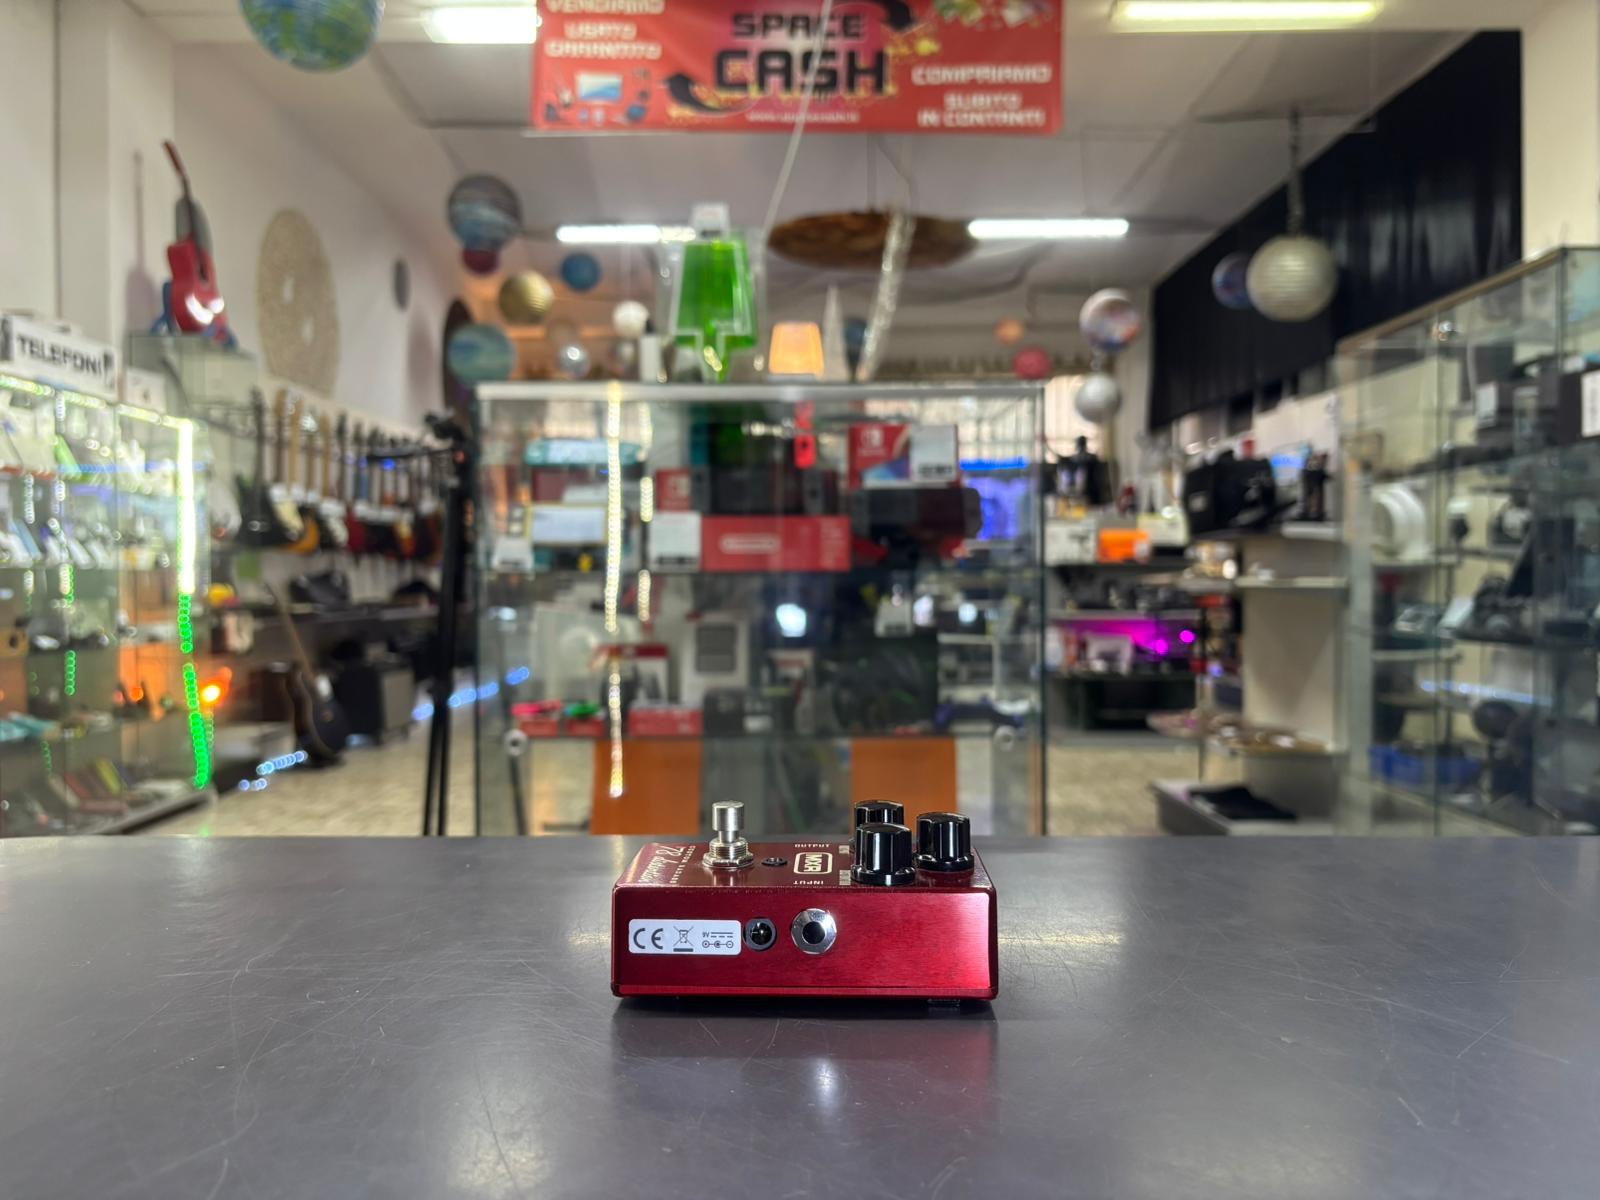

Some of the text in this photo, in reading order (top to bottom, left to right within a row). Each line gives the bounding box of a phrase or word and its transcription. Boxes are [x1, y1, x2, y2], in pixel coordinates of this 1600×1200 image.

[733, 14, 863, 38] SPACE
[716, 51, 885, 94] CASH
[911, 64, 1051, 85] COMPRIAMO
[917, 109, 940, 127] IN
[17, 334, 102, 375] TELEFONI
[804, 852, 822, 872] MXR
